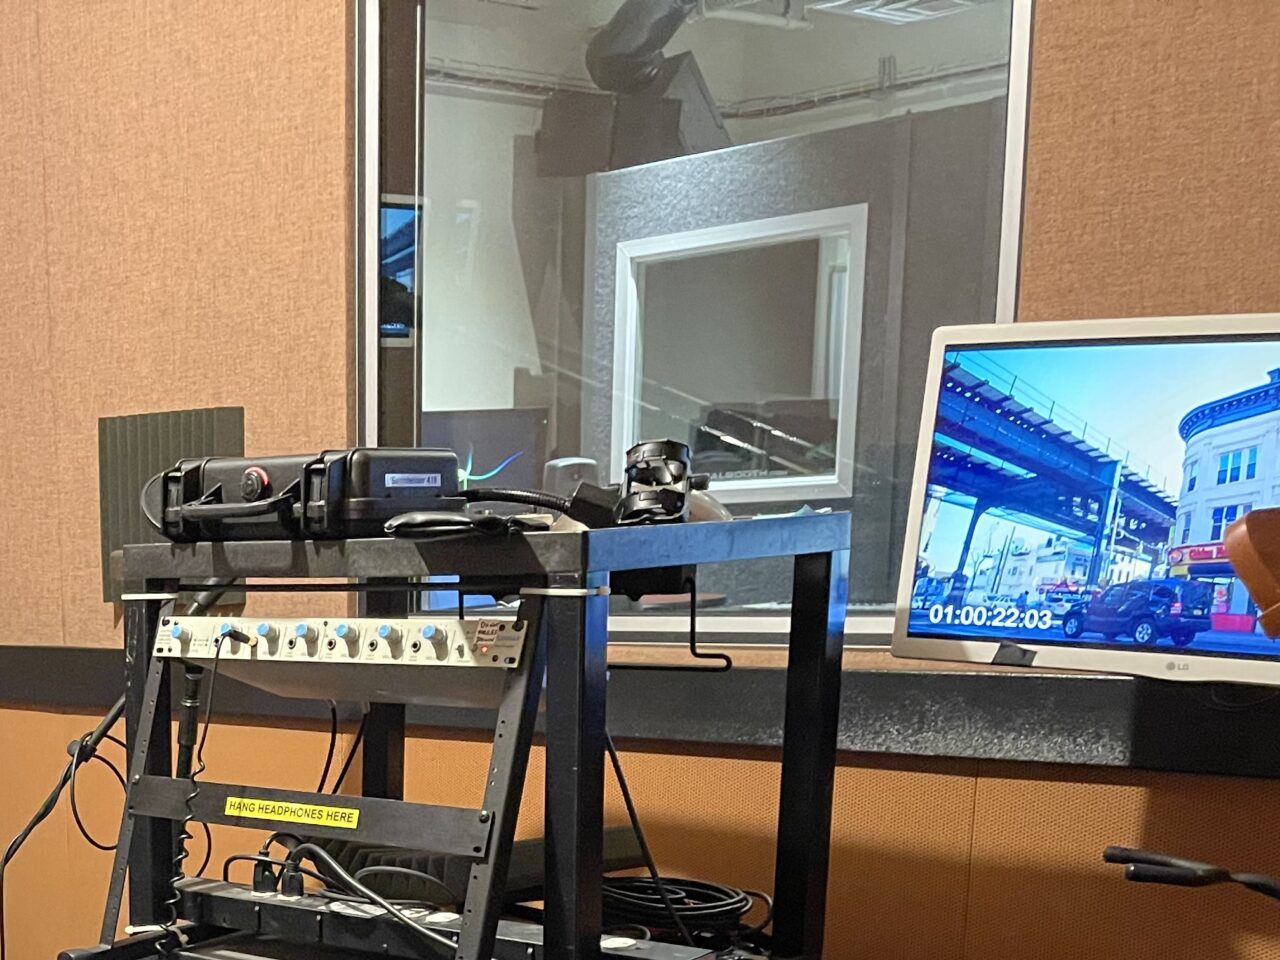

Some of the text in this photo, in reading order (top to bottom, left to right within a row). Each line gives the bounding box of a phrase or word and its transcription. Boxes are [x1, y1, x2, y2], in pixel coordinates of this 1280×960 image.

[929, 603, 1053, 630] 01:00:22:03
[229, 800, 354, 823] HANG HEADPHONES HERE
